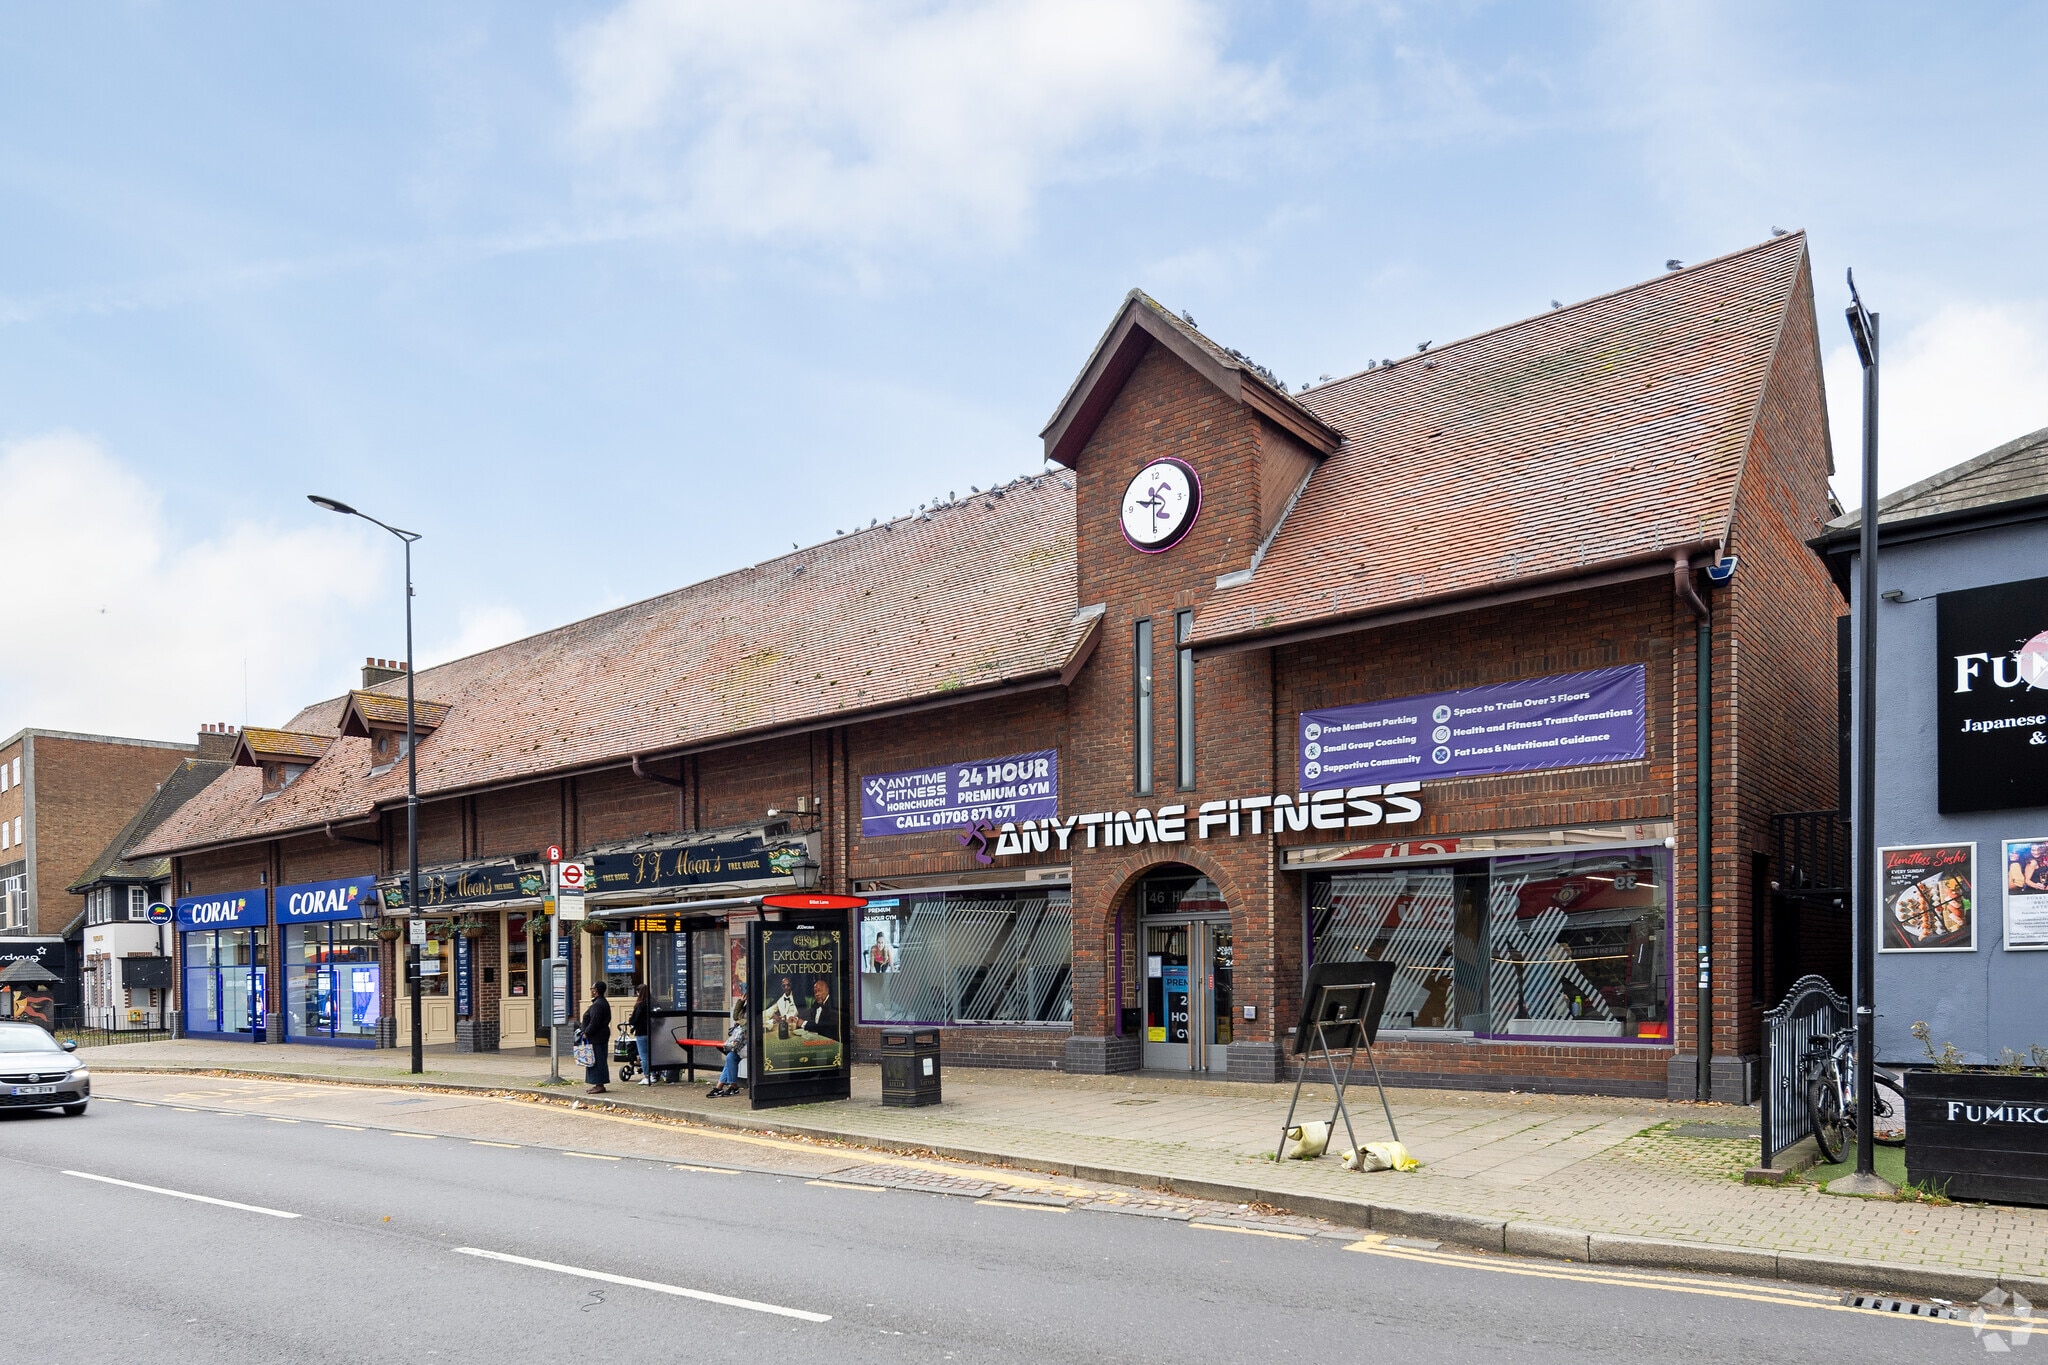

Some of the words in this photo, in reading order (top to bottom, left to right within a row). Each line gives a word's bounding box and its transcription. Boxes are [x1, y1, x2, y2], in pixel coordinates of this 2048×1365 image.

[1152, 472, 1160, 480] 12
[1453, 706, 1482, 717] Space
[1484, 704, 1494, 712] to
[1496, 701, 1523, 711] Train
[1524, 698, 1549, 708] Over
[1550, 696, 1556, 704] 3
[1557, 691, 1590, 703] Floors
[1323, 726, 1341, 734] Free
[1342, 720, 1381, 731] Members
[1382, 715, 1418, 726] Parking
[1453, 726, 1485, 737] Health
[1486, 723, 1505, 733] and
[1506, 719, 1543, 731] Fitness
[1544, 708, 1633, 726] Transformations
[1961, 714, 2046, 733] Japanese
[1323, 743, 1347, 753] Small
[1348, 741, 1375, 751] Group
[1375, 735, 1417, 747] Coaching
[1454, 748, 1471, 757] Fat
[1471, 746, 1493, 755] Loss
[1494, 744, 1502, 752] &
[1503, 738, 1559, 752] Nutritional
[1560, 733, 1610, 746] Guidance
[2029, 731, 2047, 745] &
[1323, 760, 1369, 773] Supportive
[1370, 754, 1421, 767] Community
[886, 771, 946, 790] ANYTIME
[958, 768, 983, 789] 24
[986, 758, 1049, 785] HOUR
[886, 785, 946, 802] FITNESS
[957, 785, 1016, 804] PREMIUM
[1018, 781, 1050, 797] GYM
[887, 797, 946, 812] HORNCHURCH
[896, 816, 931, 829] CALL:
[932, 810, 969, 825] 01708
[971, 807, 992, 821] 871
[994, 804, 1016, 818] 671
[994, 804, 1186, 856] ANYTIME
[1199, 781, 1422, 840] FITNESS
[550, 849, 559, 859] B
[666, 847, 721, 877] Moon's
[727, 862, 742, 871] FREE
[742, 860, 760, 869] HOUSE
[1887, 852, 1931, 868] Limitless
[1933, 850, 1966, 867] Sushi
[450, 870, 492, 898] Moon's
[289, 888, 348, 915] CORAL
[1149, 891, 1165, 903] 46
[192, 900, 238, 923] CORAL
[773, 950, 812, 961] EXPLORE
[812, 950, 833, 960] GIN'S
[773, 964, 799, 974] NEXT
[799, 963, 833, 973] EPISODE
[1947, 1101, 2048, 1123] FUMIKO
